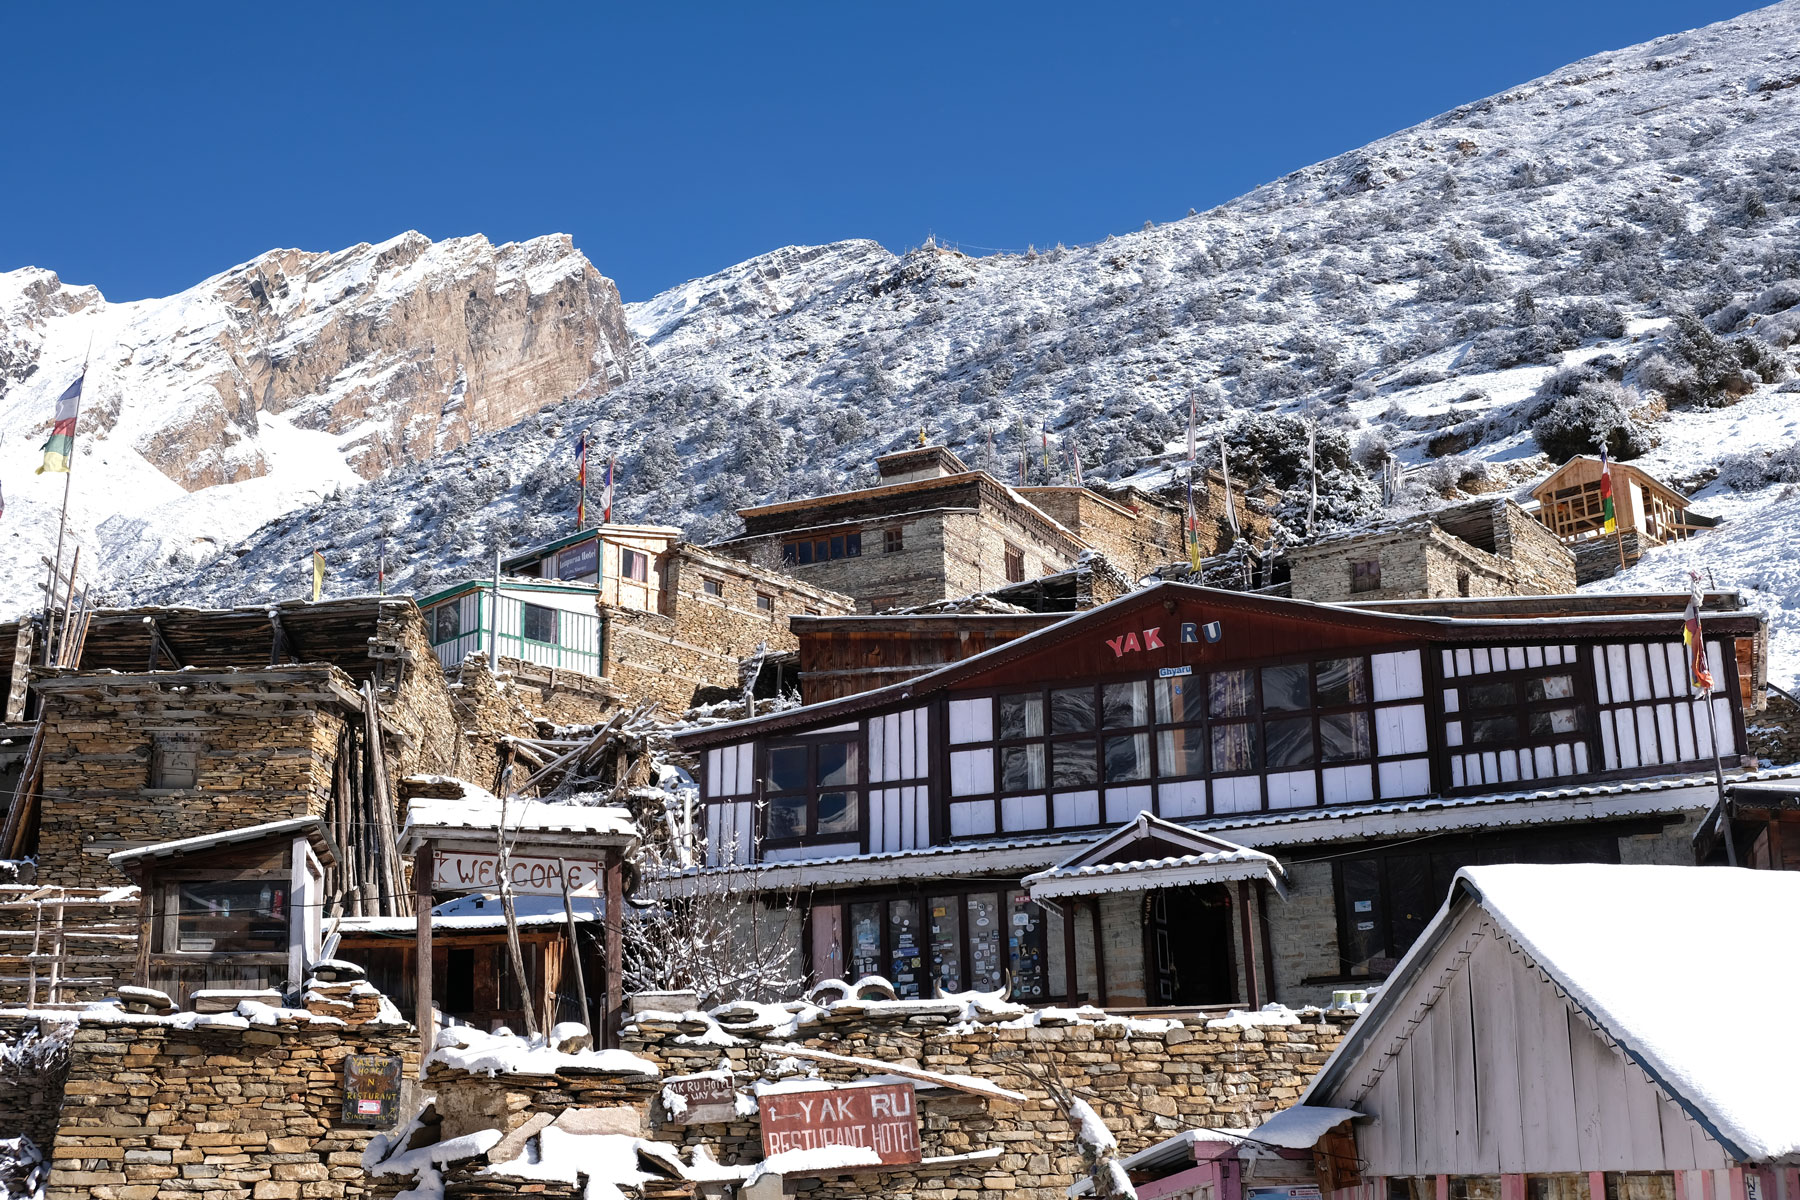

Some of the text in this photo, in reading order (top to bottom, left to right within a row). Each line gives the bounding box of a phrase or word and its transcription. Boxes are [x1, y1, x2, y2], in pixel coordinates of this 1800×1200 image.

[1106, 620, 1222, 657] YAK RU
[1160, 666, 1191, 676] Ghyaru
[367, 1078, 375, 1086] N
[687, 1081, 700, 1092] RU
[691, 1091, 709, 1101] WAY
[799, 1091, 911, 1123] YAK RU
[871, 1121, 919, 1154] HOTEL
